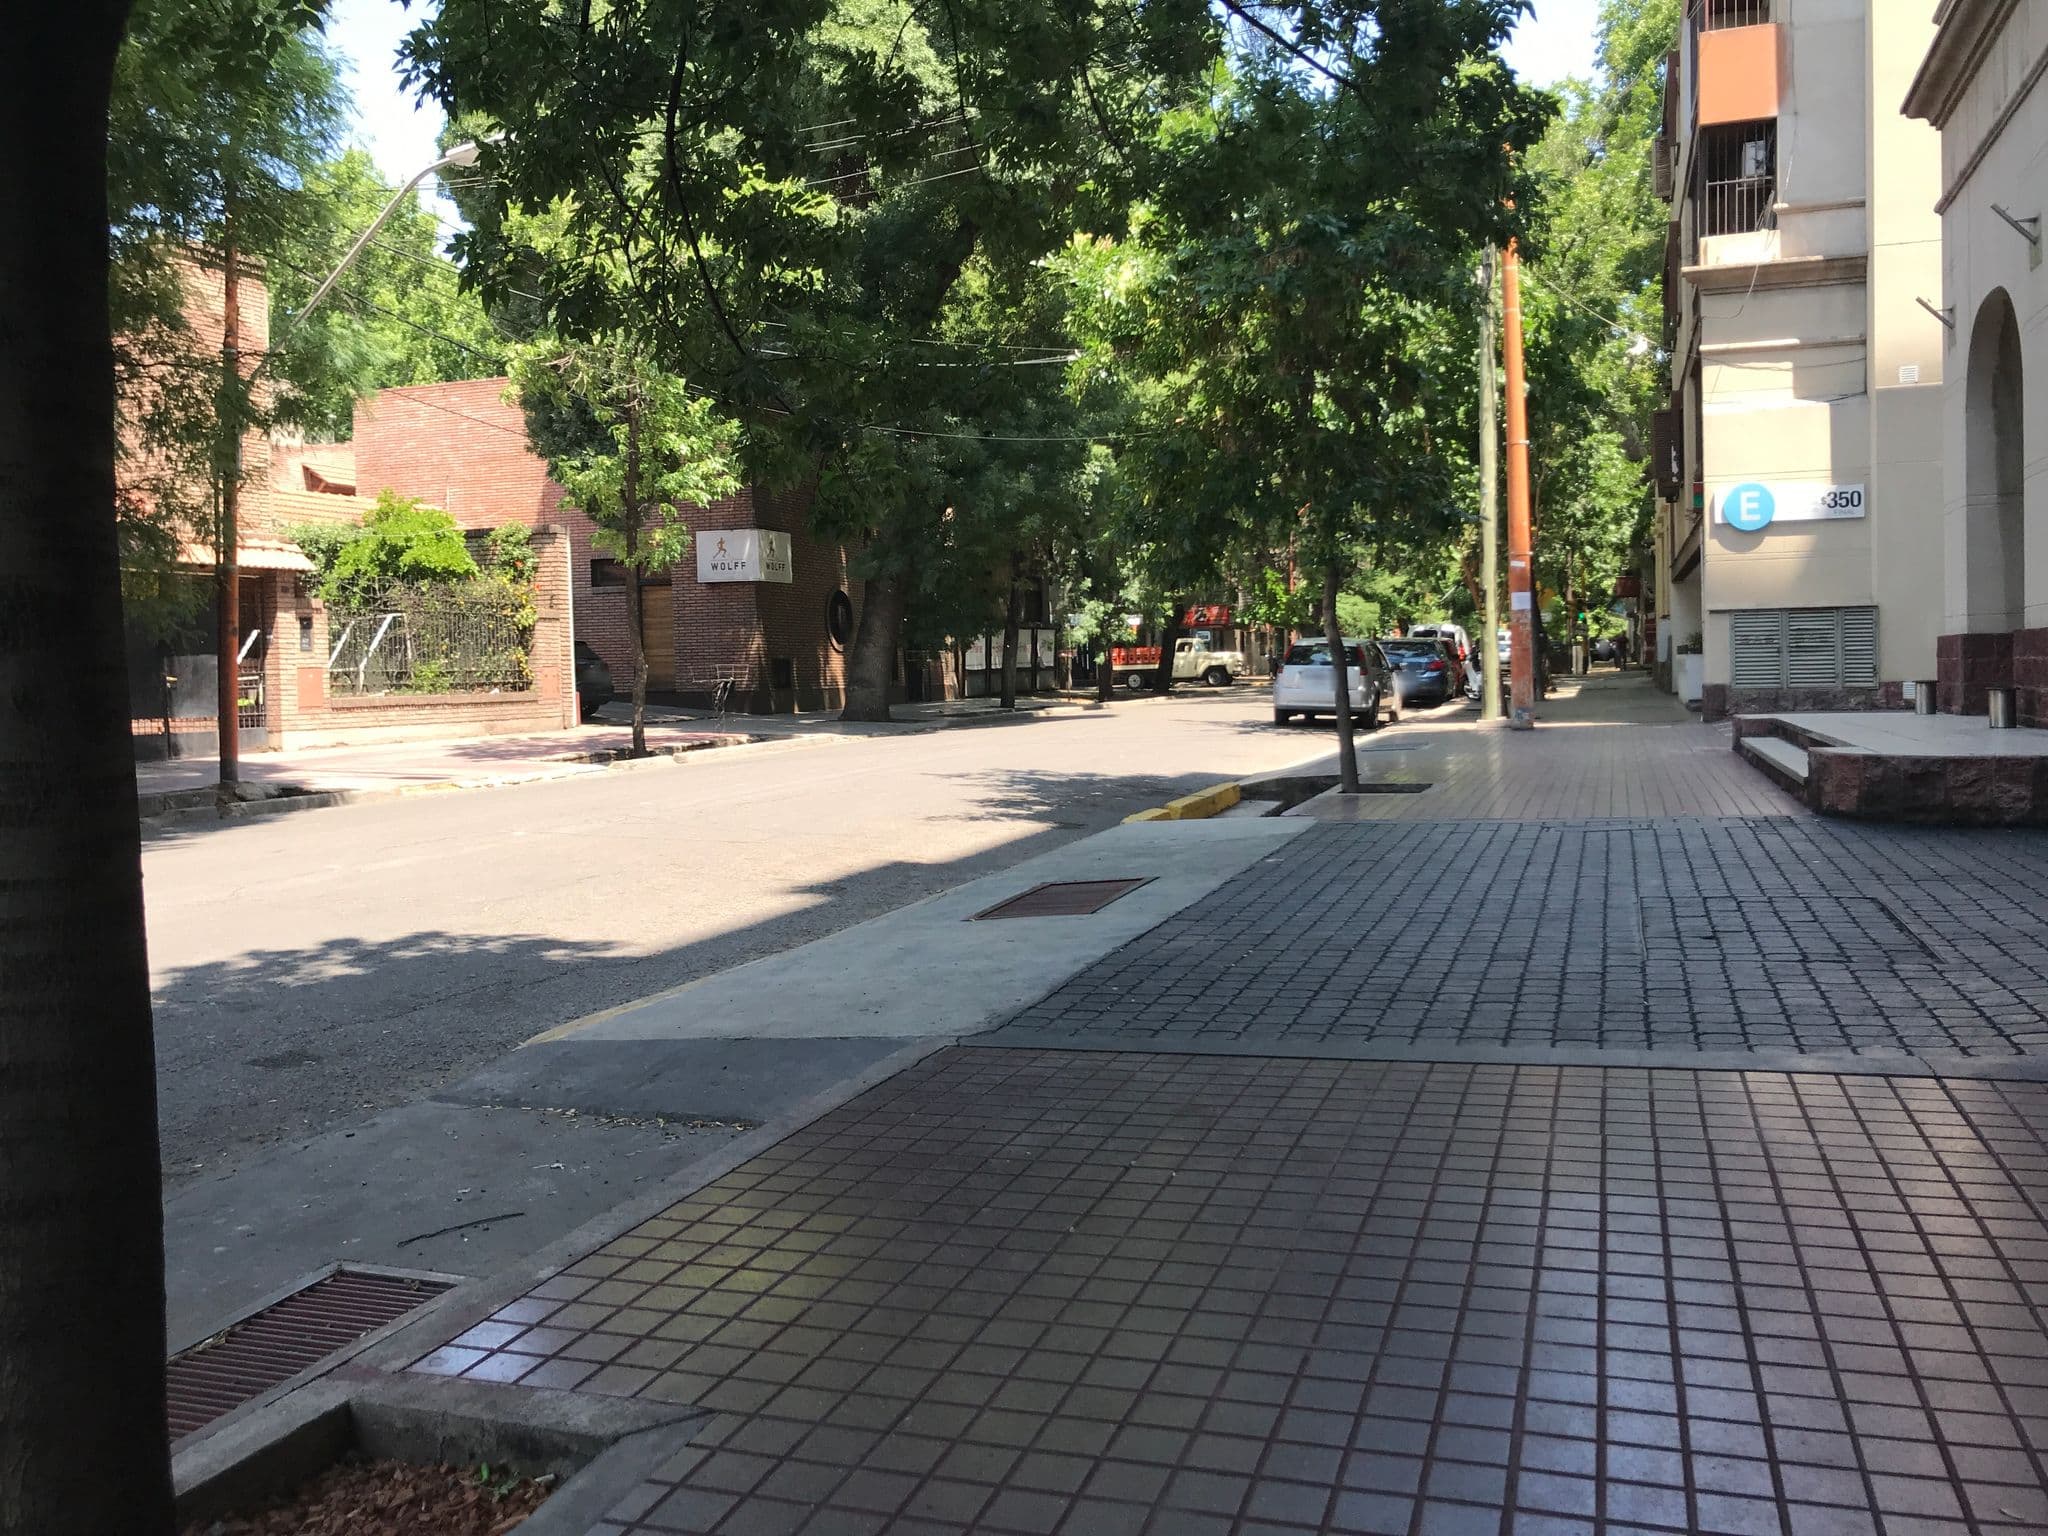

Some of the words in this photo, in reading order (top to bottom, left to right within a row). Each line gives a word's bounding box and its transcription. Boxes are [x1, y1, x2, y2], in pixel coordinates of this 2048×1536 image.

[1740, 490, 1760, 521] E
[711, 561, 746, 571] WOLFF
[766, 561, 785, 571] WOLFF
